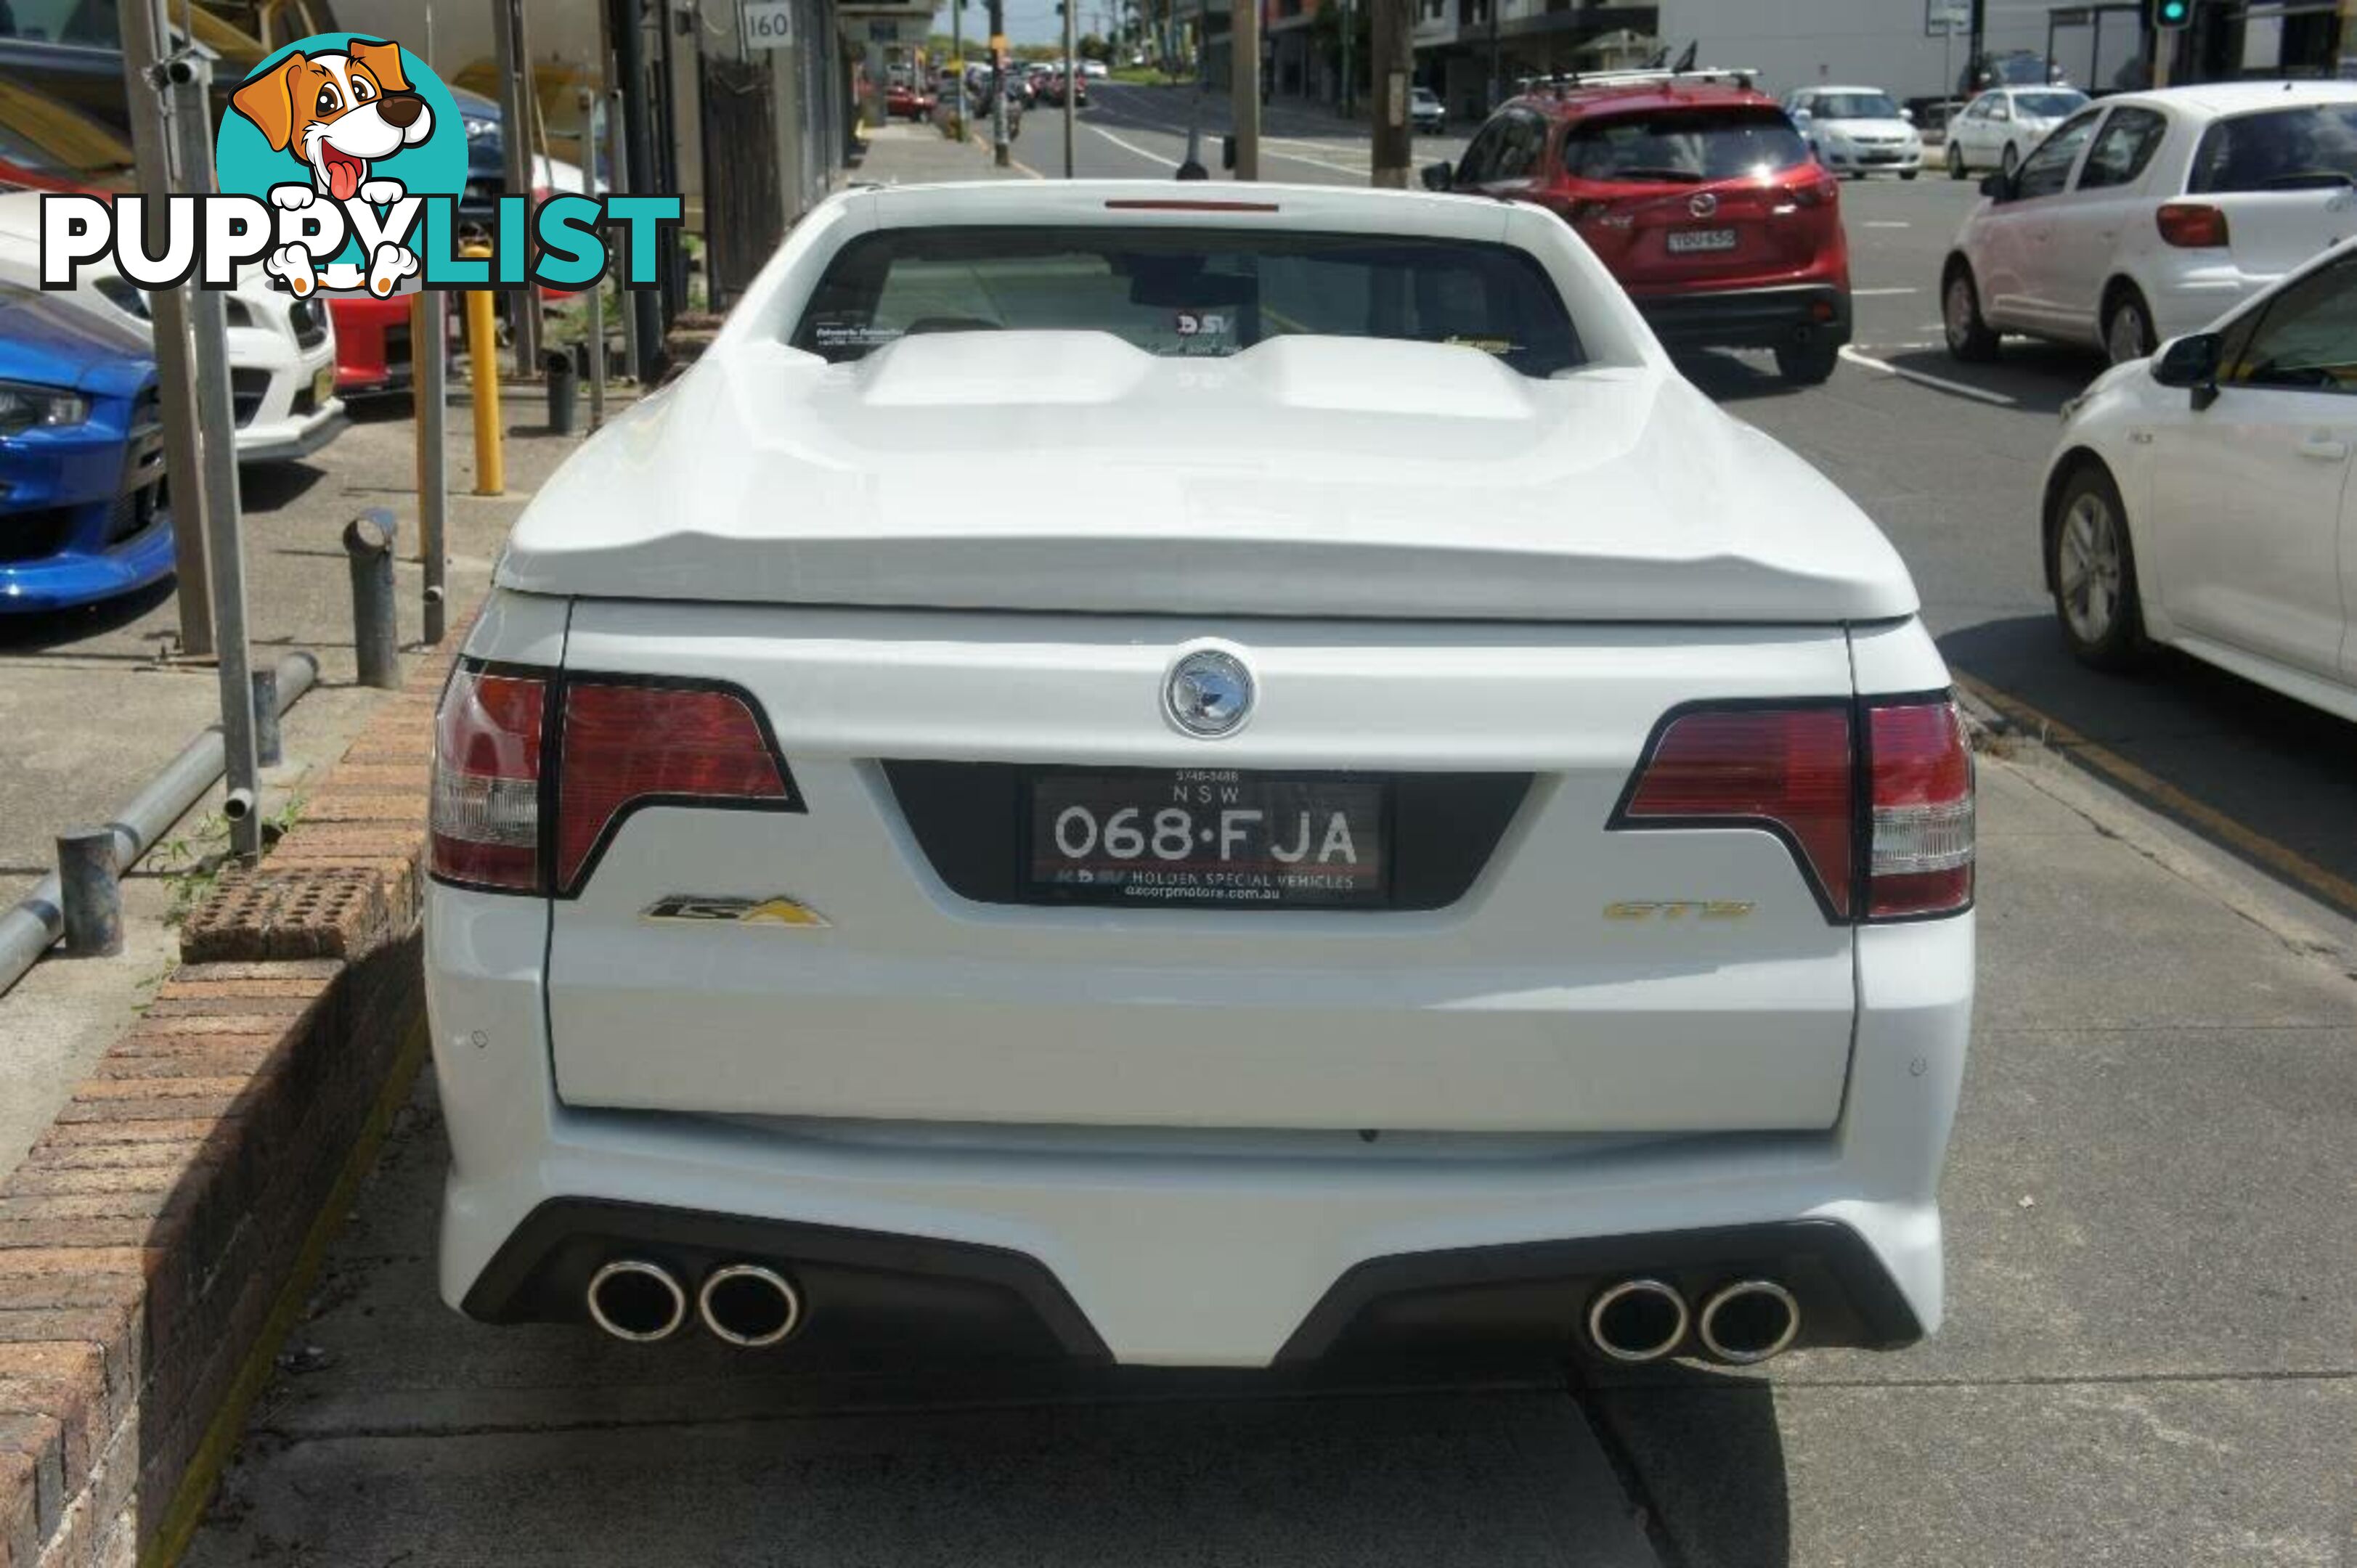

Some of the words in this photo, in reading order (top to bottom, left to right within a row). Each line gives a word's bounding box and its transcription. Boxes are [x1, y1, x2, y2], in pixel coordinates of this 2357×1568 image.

[749, 12, 788, 37] 160
[1173, 785, 1239, 804] NSW
[1131, 871, 1197, 885] HOLDEN
[1206, 873, 1271, 887] SPECIAL
[1277, 875, 1353, 889] VEHICLES
